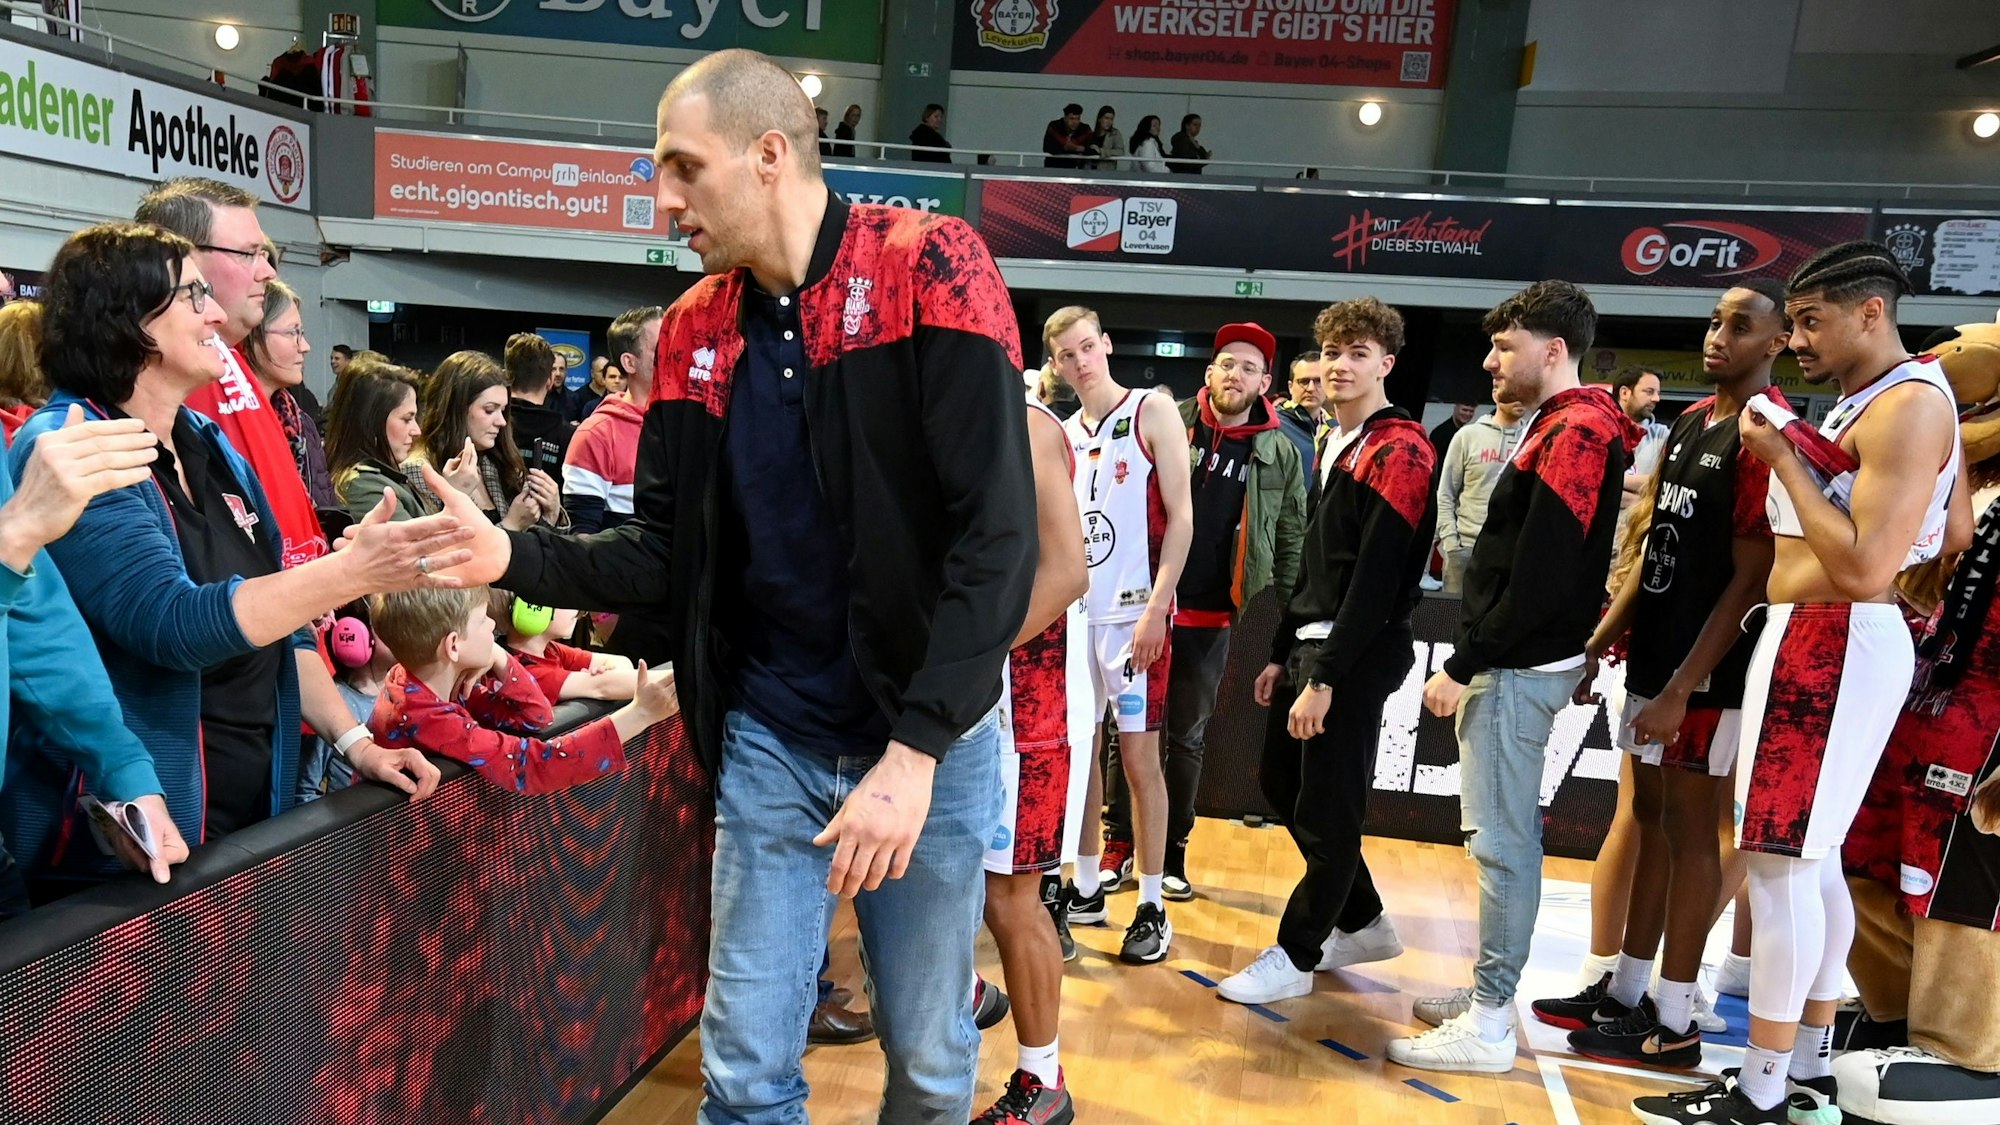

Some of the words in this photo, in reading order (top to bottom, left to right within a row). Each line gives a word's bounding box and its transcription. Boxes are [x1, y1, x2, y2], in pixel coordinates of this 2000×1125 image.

[1114, 5, 1269, 39] WERKSELF
[1272, 11, 1363, 42] GIBT'S
[1366, 15, 1435, 46] HIER
[984, 32, 1041, 46] Leverkusen
[0, 59, 114, 146] adener
[128, 88, 260, 179] Apotheke
[390, 153, 464, 174] Studieren
[467, 163, 492, 175] am
[390, 180, 608, 217] echt.gigantisch.gut!
[1138, 201, 1164, 213] TSV
[1127, 210, 1173, 229] Bayer
[1396, 211, 1493, 243] Abstand
[1138, 230, 1157, 241] 04
[1123, 241, 1171, 251] Leverkusen
[1371, 238, 1483, 256] DIEBESTEWAHL
[1635, 234, 1741, 269] GoFit
[689, 365, 712, 382] erre
[1144, 366, 1155, 380] 6
[339, 633, 356, 643] kid
